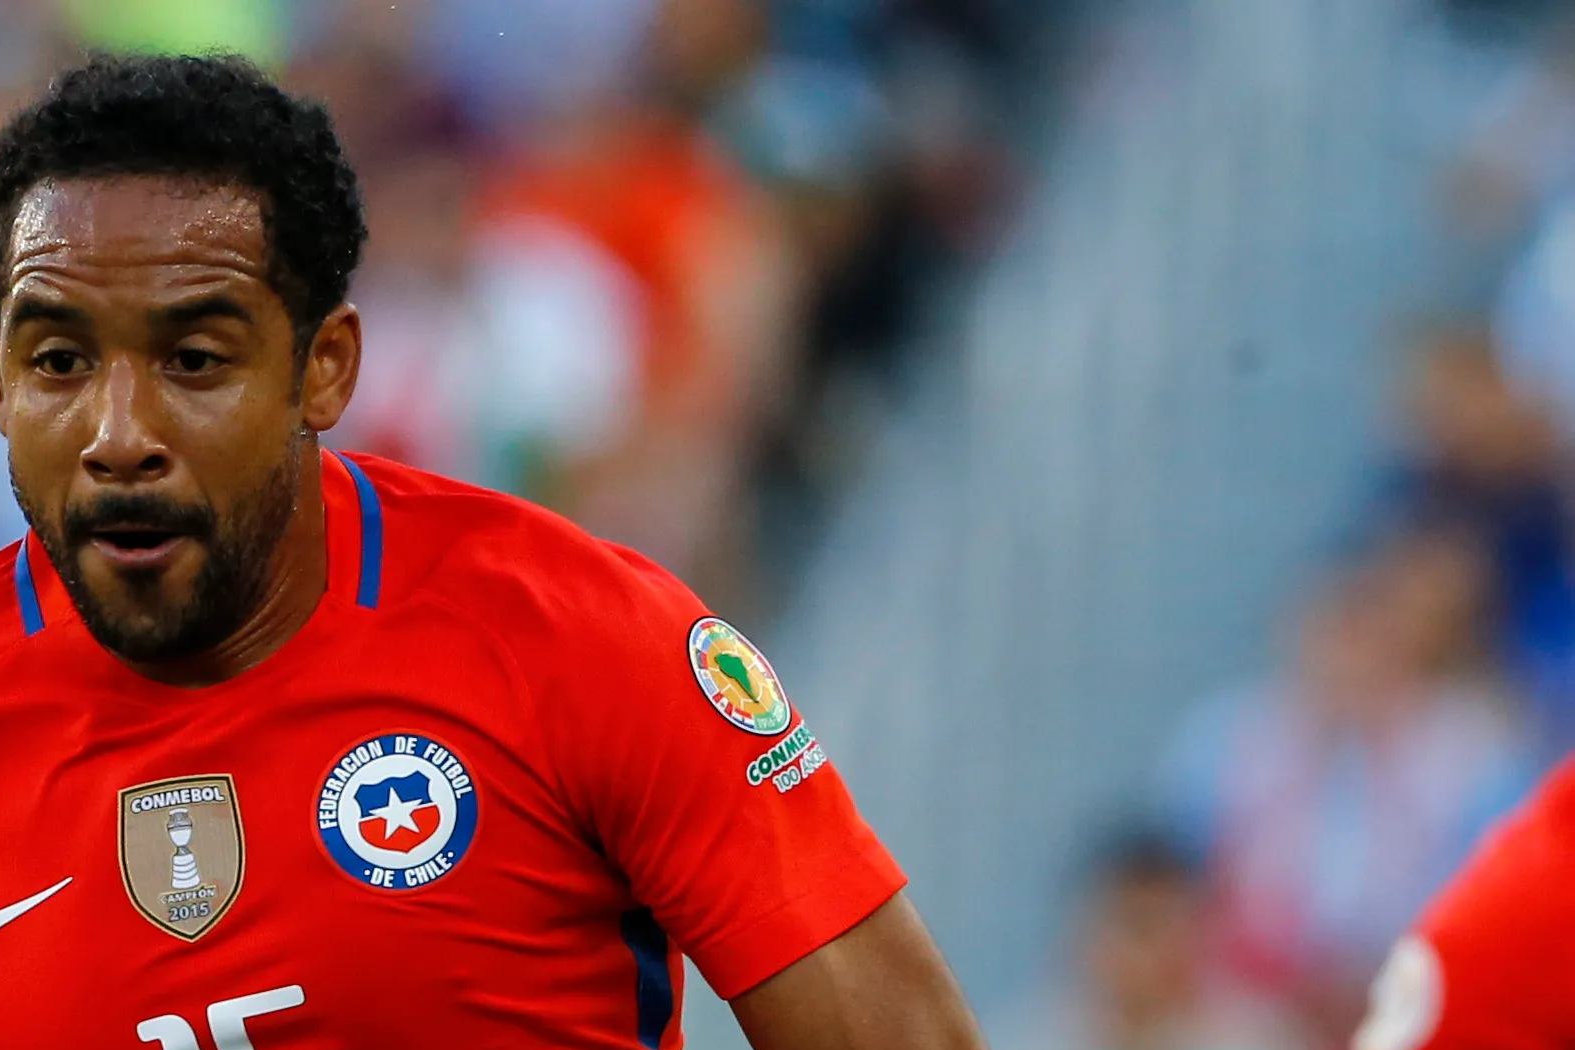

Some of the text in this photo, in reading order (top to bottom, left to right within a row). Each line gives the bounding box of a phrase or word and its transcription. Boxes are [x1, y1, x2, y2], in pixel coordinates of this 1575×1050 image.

[318, 736, 473, 830] FEDERACION DE FUTBOL
[774, 767, 800, 791] 100
[131, 786, 225, 813] CONMEBOL
[169, 902, 210, 922] 2015
